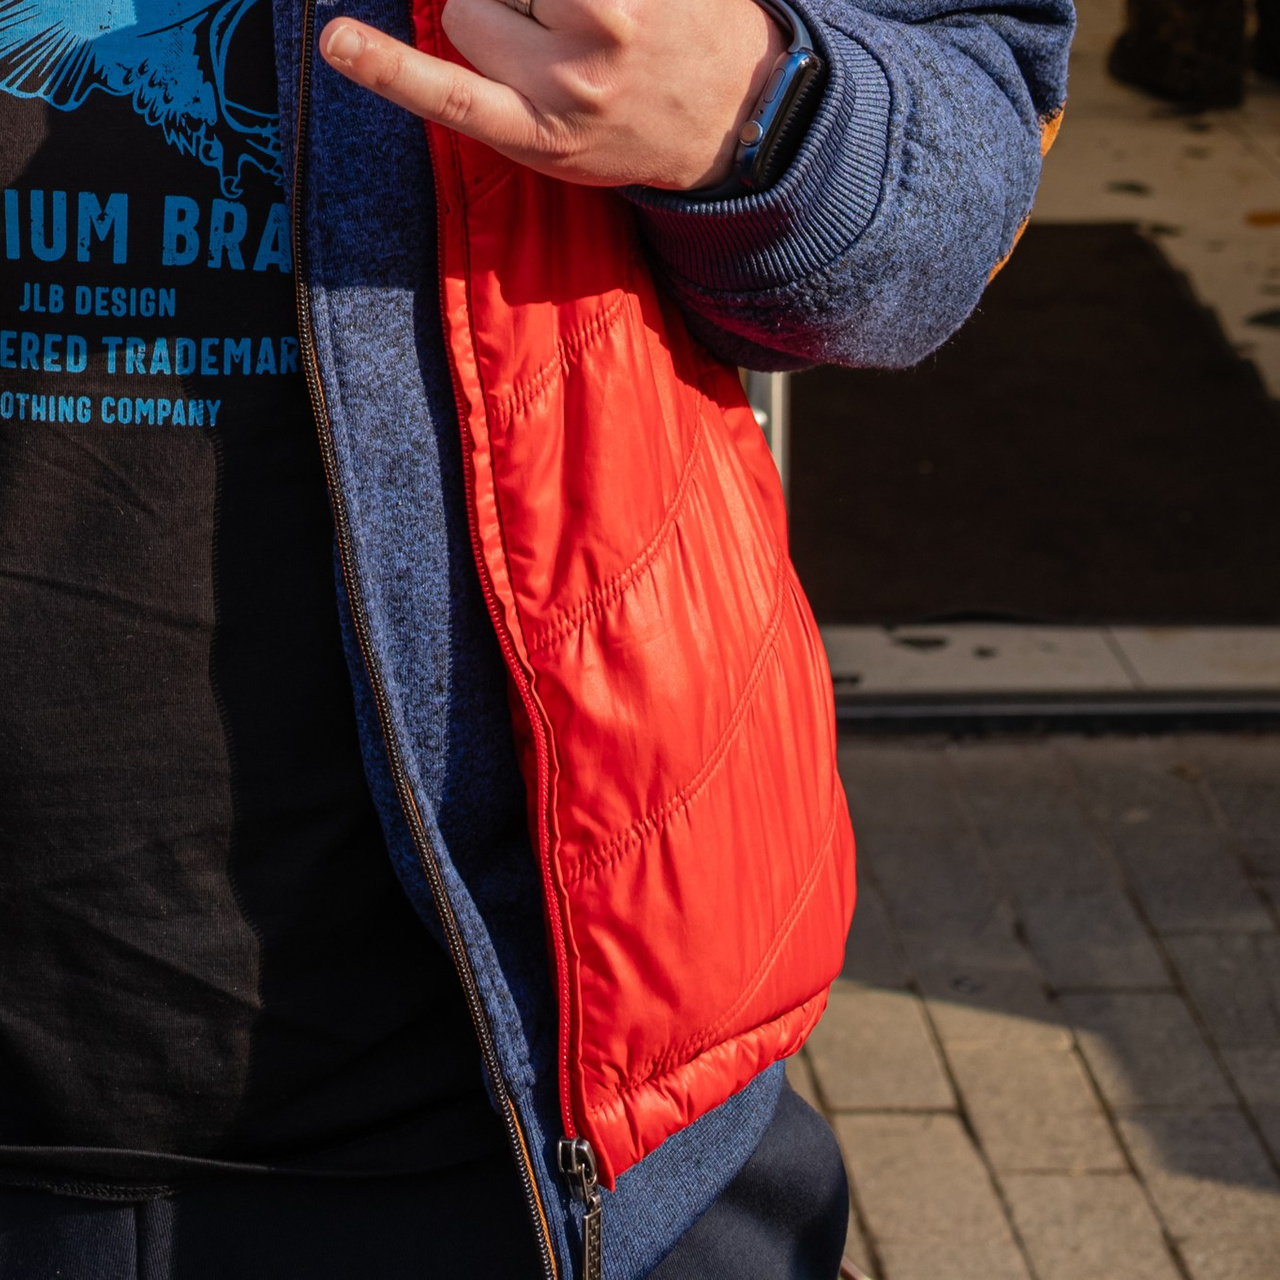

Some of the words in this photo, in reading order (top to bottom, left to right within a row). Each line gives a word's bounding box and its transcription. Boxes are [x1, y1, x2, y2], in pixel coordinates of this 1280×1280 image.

[162, 195, 293, 274] BRA
[19, 282, 65, 314] JLB
[75, 285, 176, 317] DESIGN
[101, 336, 300, 376] TRADEMAR
[101, 396, 222, 427] COMPANY
